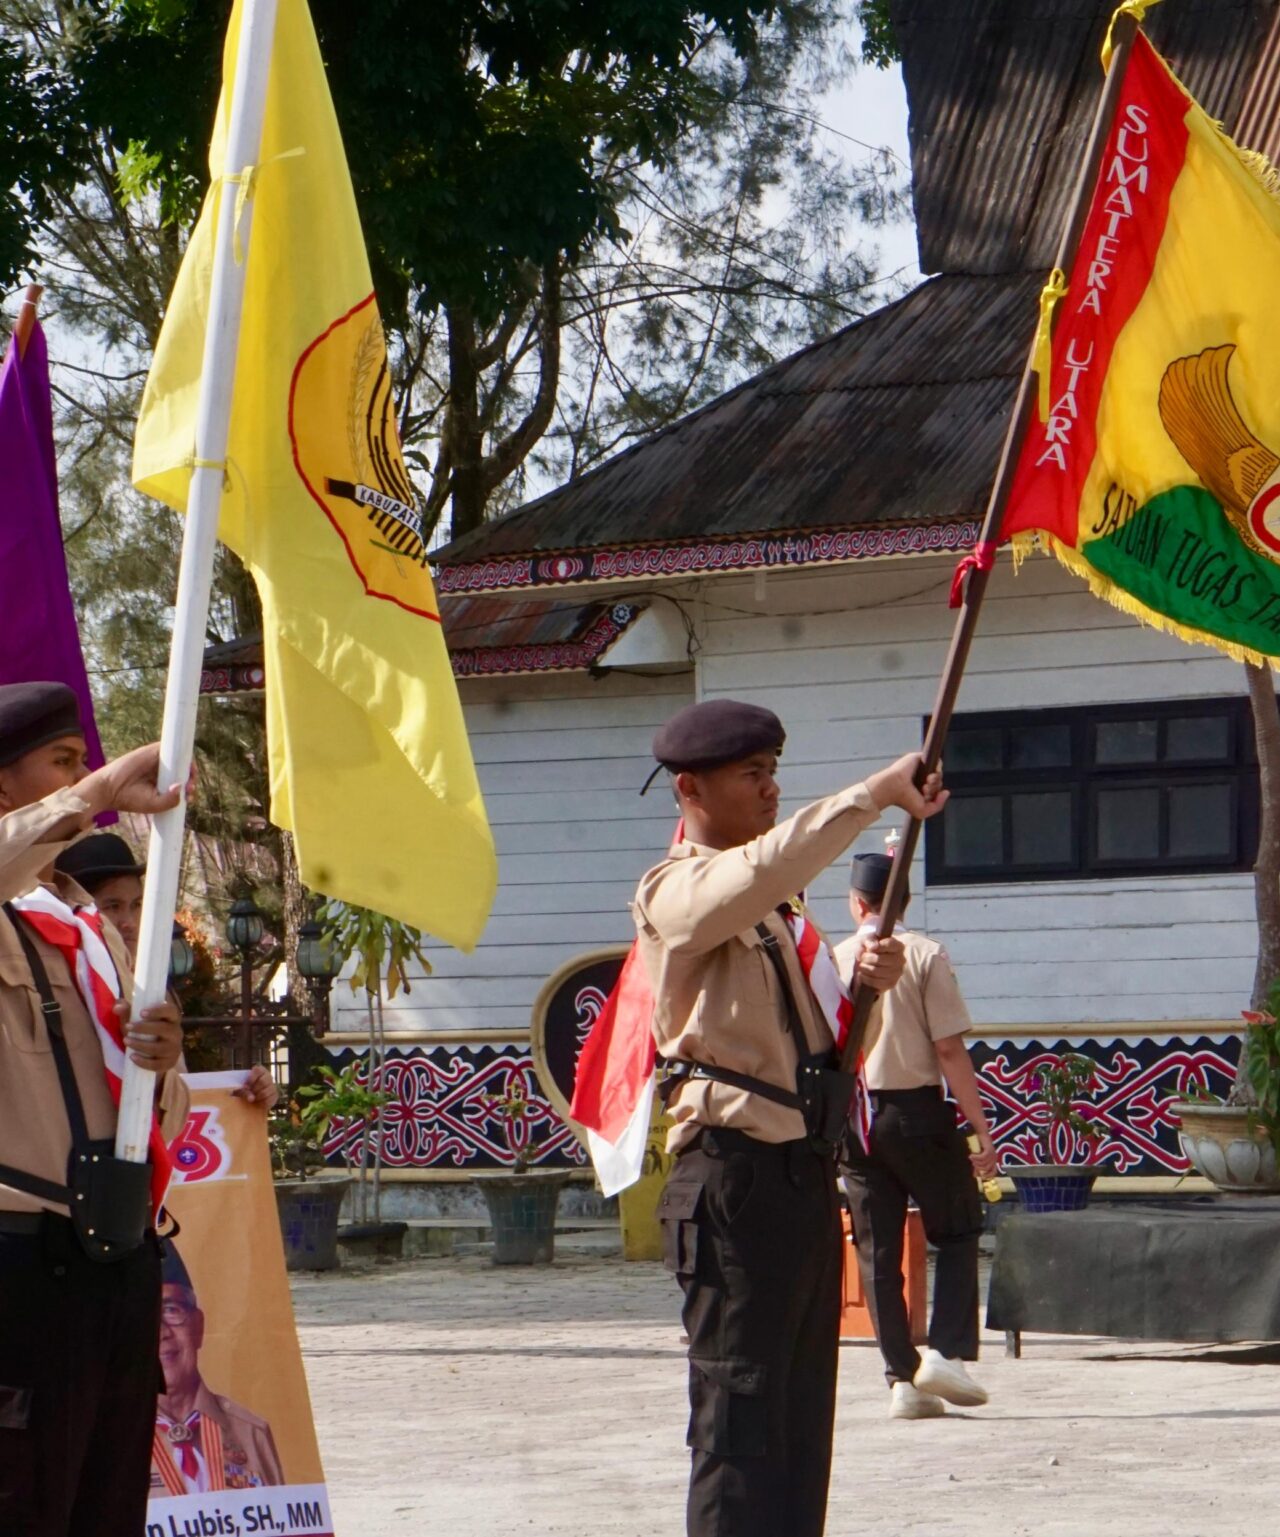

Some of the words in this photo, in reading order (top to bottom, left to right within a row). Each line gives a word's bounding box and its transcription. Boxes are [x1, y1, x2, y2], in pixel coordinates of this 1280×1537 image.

[1077, 104, 1149, 316] SUMATERA
[1035, 338, 1094, 471] UTARA
[1092, 482, 1172, 569] SATUAN
[1167, 529, 1257, 609] TUGAS
[168, 1509, 240, 1537] Lubis,
[243, 1505, 285, 1533] SH.,
[287, 1502, 323, 1528] MM
